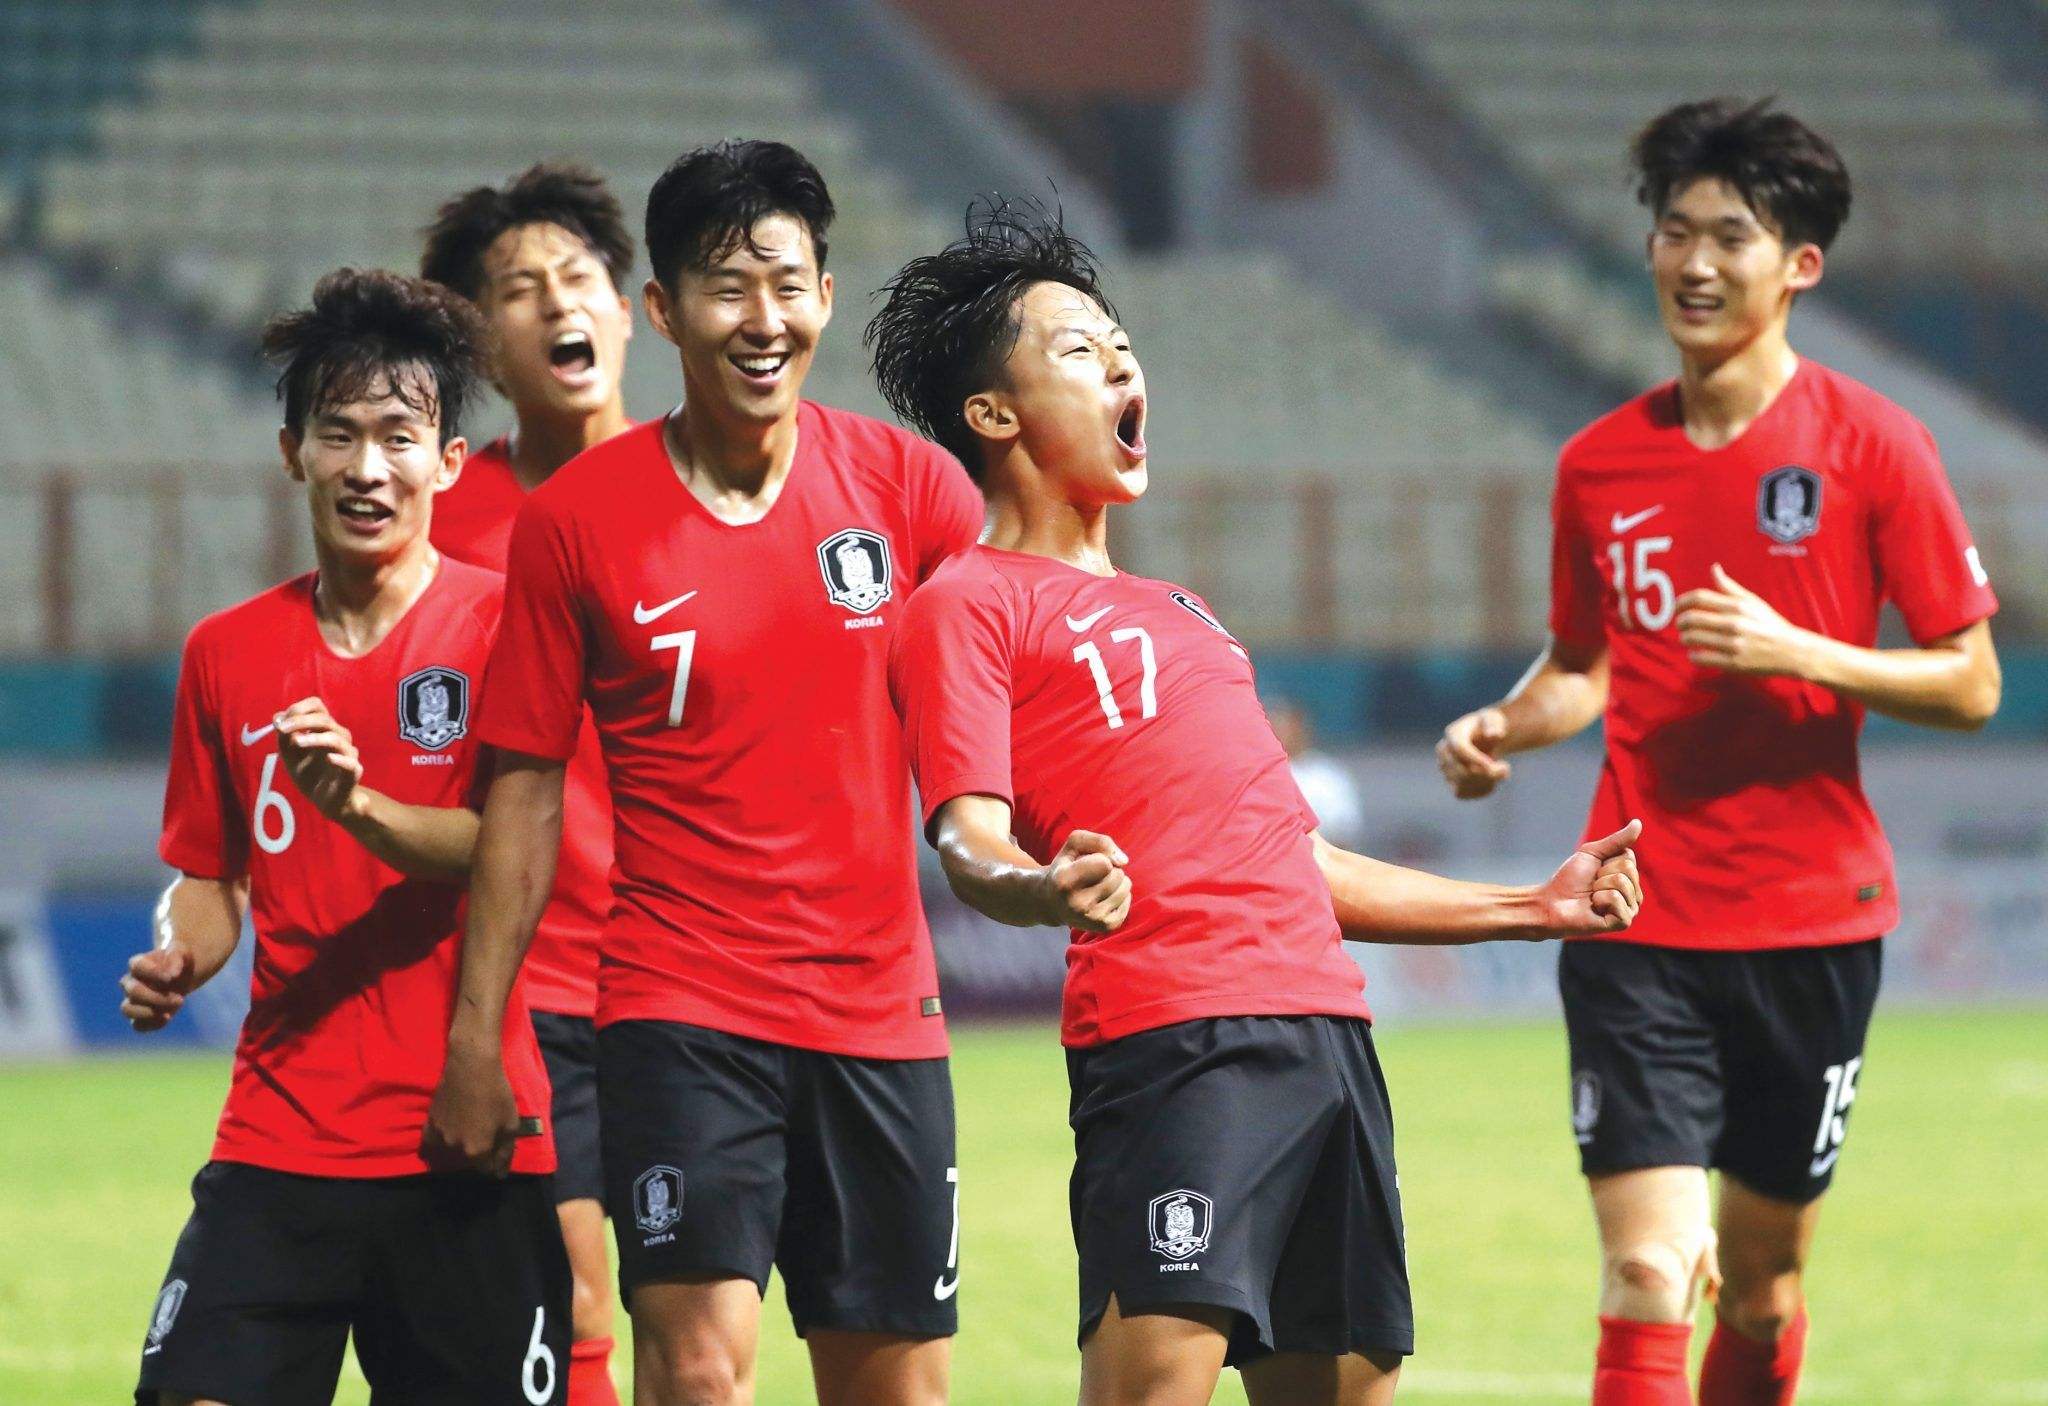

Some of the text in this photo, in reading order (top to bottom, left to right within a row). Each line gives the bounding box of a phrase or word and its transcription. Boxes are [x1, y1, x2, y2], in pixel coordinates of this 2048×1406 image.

[844, 616, 884, 630] KOREA
[1607, 535, 1676, 632] 15
[650, 630, 697, 727] 7
[1073, 627, 1157, 729] 17
[254, 753, 295, 854] 6
[411, 754, 454, 766] KOREA
[1160, 1262, 1200, 1273] KOREA
[522, 1306, 556, 1406] 6
